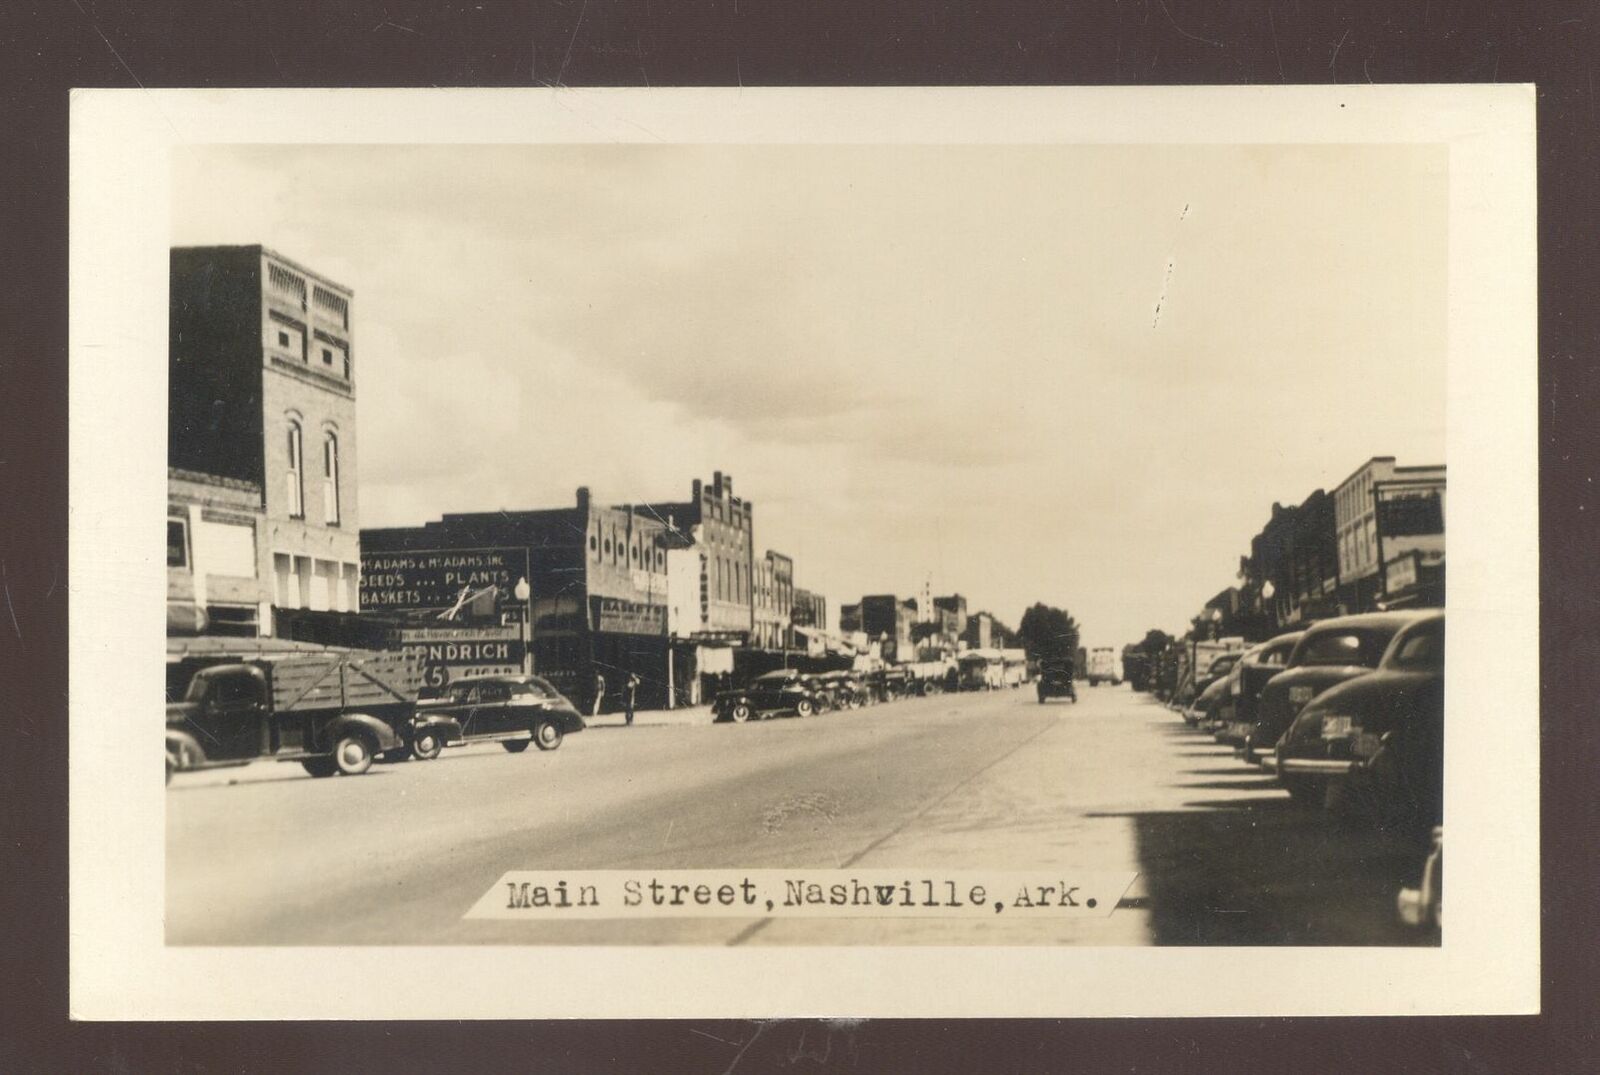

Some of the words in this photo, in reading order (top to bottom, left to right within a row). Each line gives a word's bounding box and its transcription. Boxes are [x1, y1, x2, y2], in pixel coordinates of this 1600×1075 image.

[445, 570, 510, 585] PLANTS
[360, 590, 421, 605] BASKETS
[431, 666, 444, 687] 5
